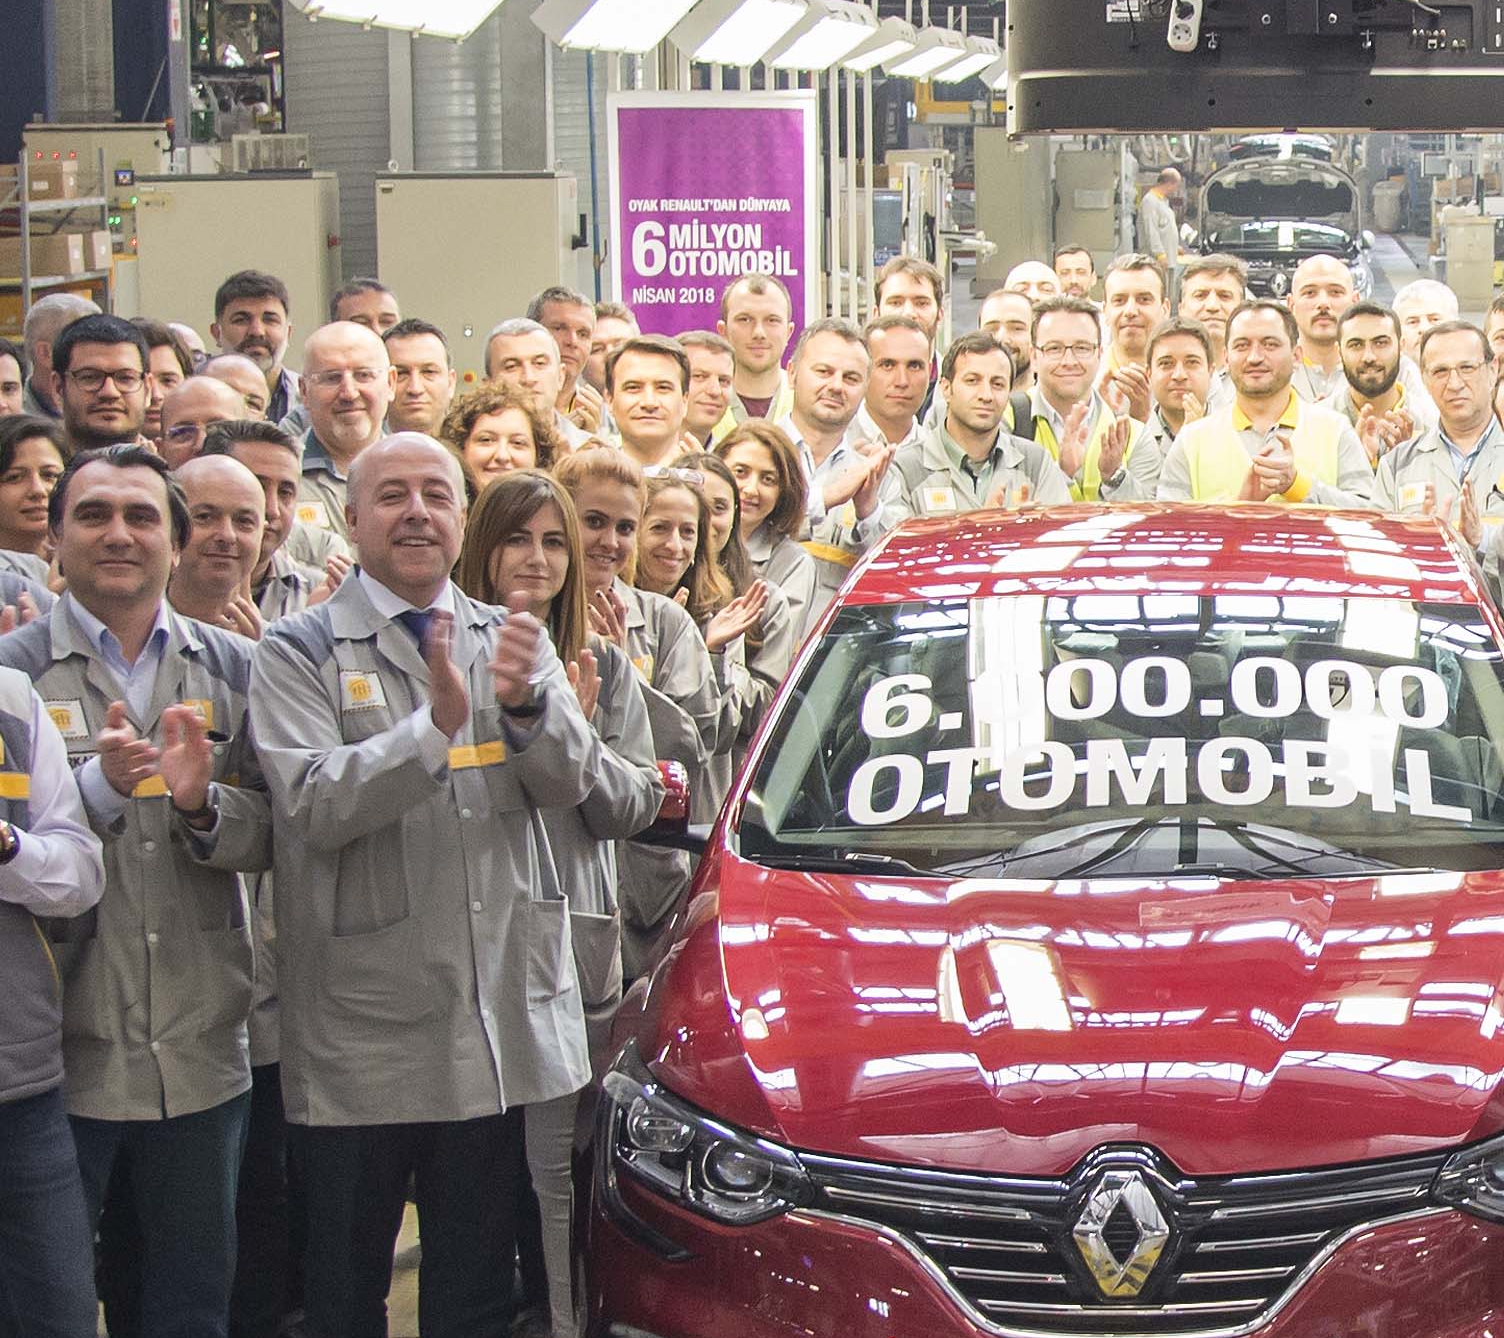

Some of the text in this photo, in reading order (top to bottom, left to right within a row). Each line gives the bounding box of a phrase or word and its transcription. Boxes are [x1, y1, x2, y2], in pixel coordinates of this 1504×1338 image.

[628, 196, 791, 212] OYAK RENAULT'DAN DÜNYAYA
[631, 220, 668, 277] 6
[669, 218, 762, 249] MİLYON
[669, 245, 798, 277] OTOMOBİL
[632, 284, 716, 304] NİSAN 2018
[861, 656, 1449, 739] 6.00.000
